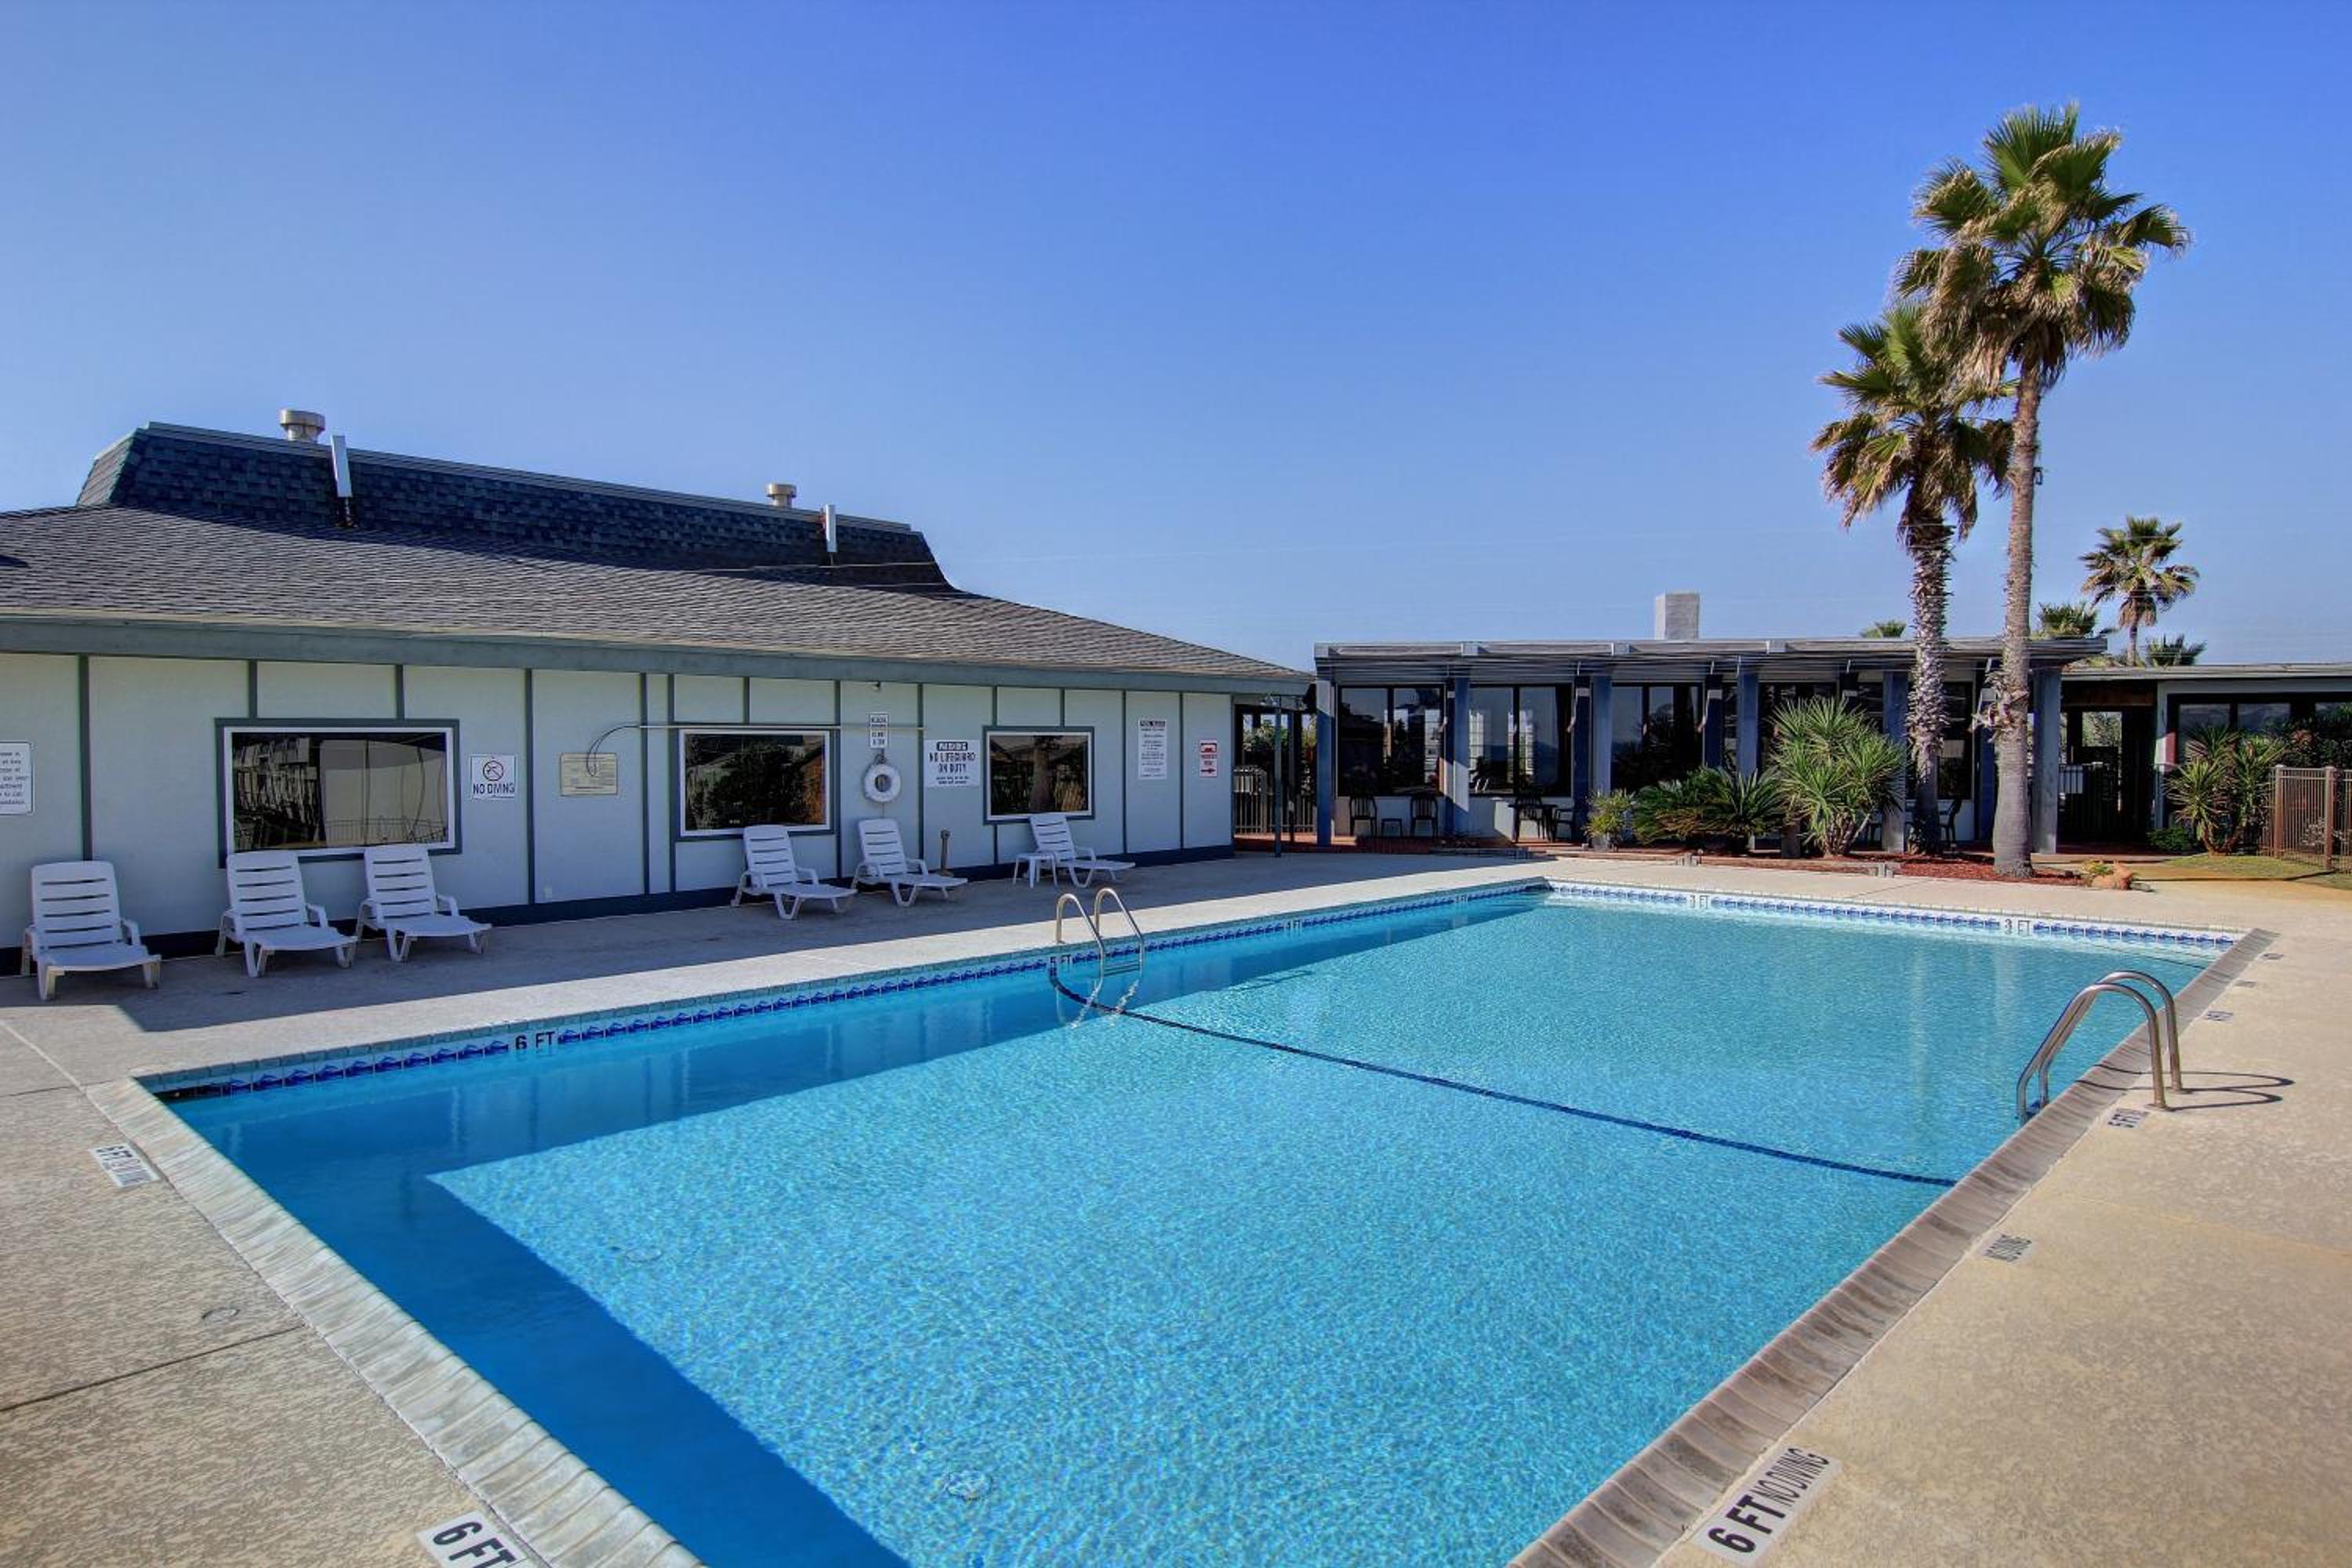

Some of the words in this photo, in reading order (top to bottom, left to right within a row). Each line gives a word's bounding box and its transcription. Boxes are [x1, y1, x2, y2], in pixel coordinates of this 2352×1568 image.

[929, 753, 938, 762] NO
[474, 784, 485, 794] NO
[2018, 920, 2031, 930] FT
[515, 1035, 528, 1050] 6
[535, 1031, 556, 1048] FT
[1766, 1448, 1831, 1490] DIVING
[1749, 1479, 1801, 1508] NO
[1726, 1494, 1786, 1534] FT
[433, 1522, 483, 1545] 6
[1708, 1527, 1756, 1553] 6
[448, 1537, 517, 1568] FT
